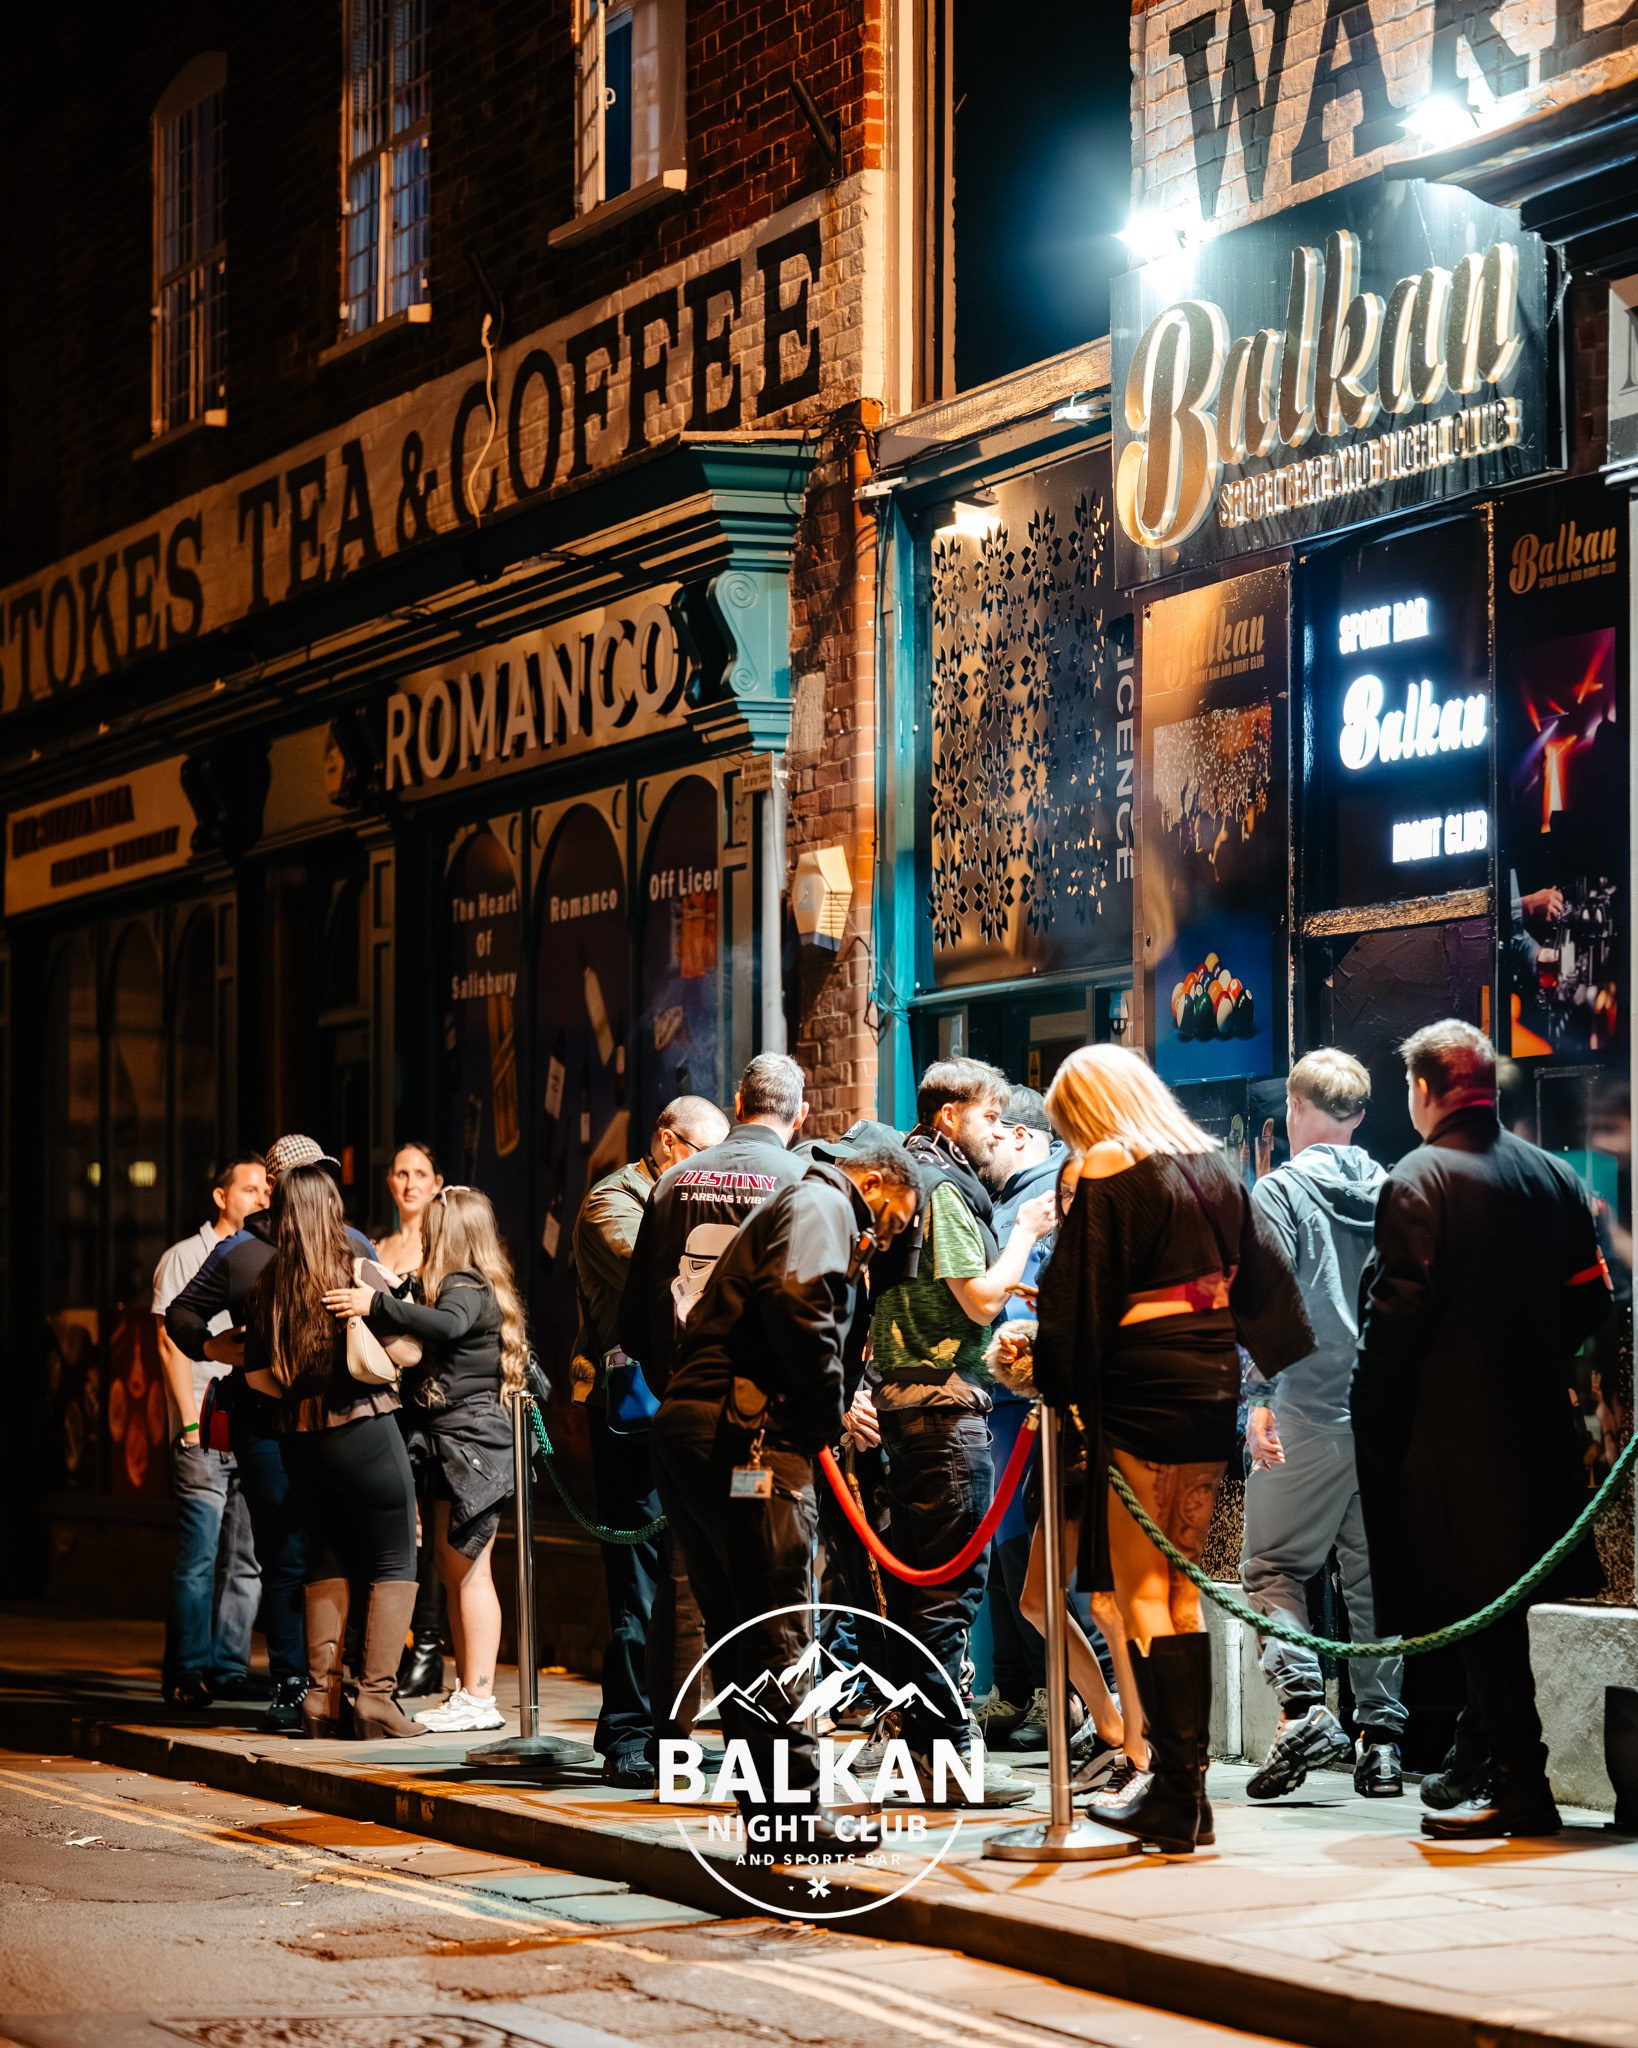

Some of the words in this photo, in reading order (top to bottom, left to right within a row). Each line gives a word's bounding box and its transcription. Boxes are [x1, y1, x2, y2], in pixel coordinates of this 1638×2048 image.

[1116, 229, 1520, 549] Balkan
[0, 510, 203, 715] TOKES
[238, 441, 385, 608] TEA
[397, 431, 438, 543] &
[451, 219, 823, 519] COFFEE
[1286, 456, 1330, 507] BAR
[1332, 440, 1374, 492] AND
[1380, 418, 1449, 480] NIGHT
[1452, 398, 1517, 458] CLUB
[1509, 520, 1617, 594] Balkan
[1163, 606, 1265, 690] Balkan
[1250, 654, 1265, 670] CLUB
[385, 602, 683, 790] ROMANCO
[1339, 674, 1488, 770] Balkan
[1444, 810, 1488, 855] CLUB
[452, 897, 476, 924] The
[478, 888, 518, 918] Heart
[550, 888, 619, 924] Romanco
[649, 869, 675, 901] Off
[451, 971, 518, 1000] Salisbury
[674, 1169, 778, 1192] DESTINY
[680, 1192, 689, 1201] 3
[691, 1192, 734, 1204] ARENAS
[735, 1196, 741, 1204] 1
